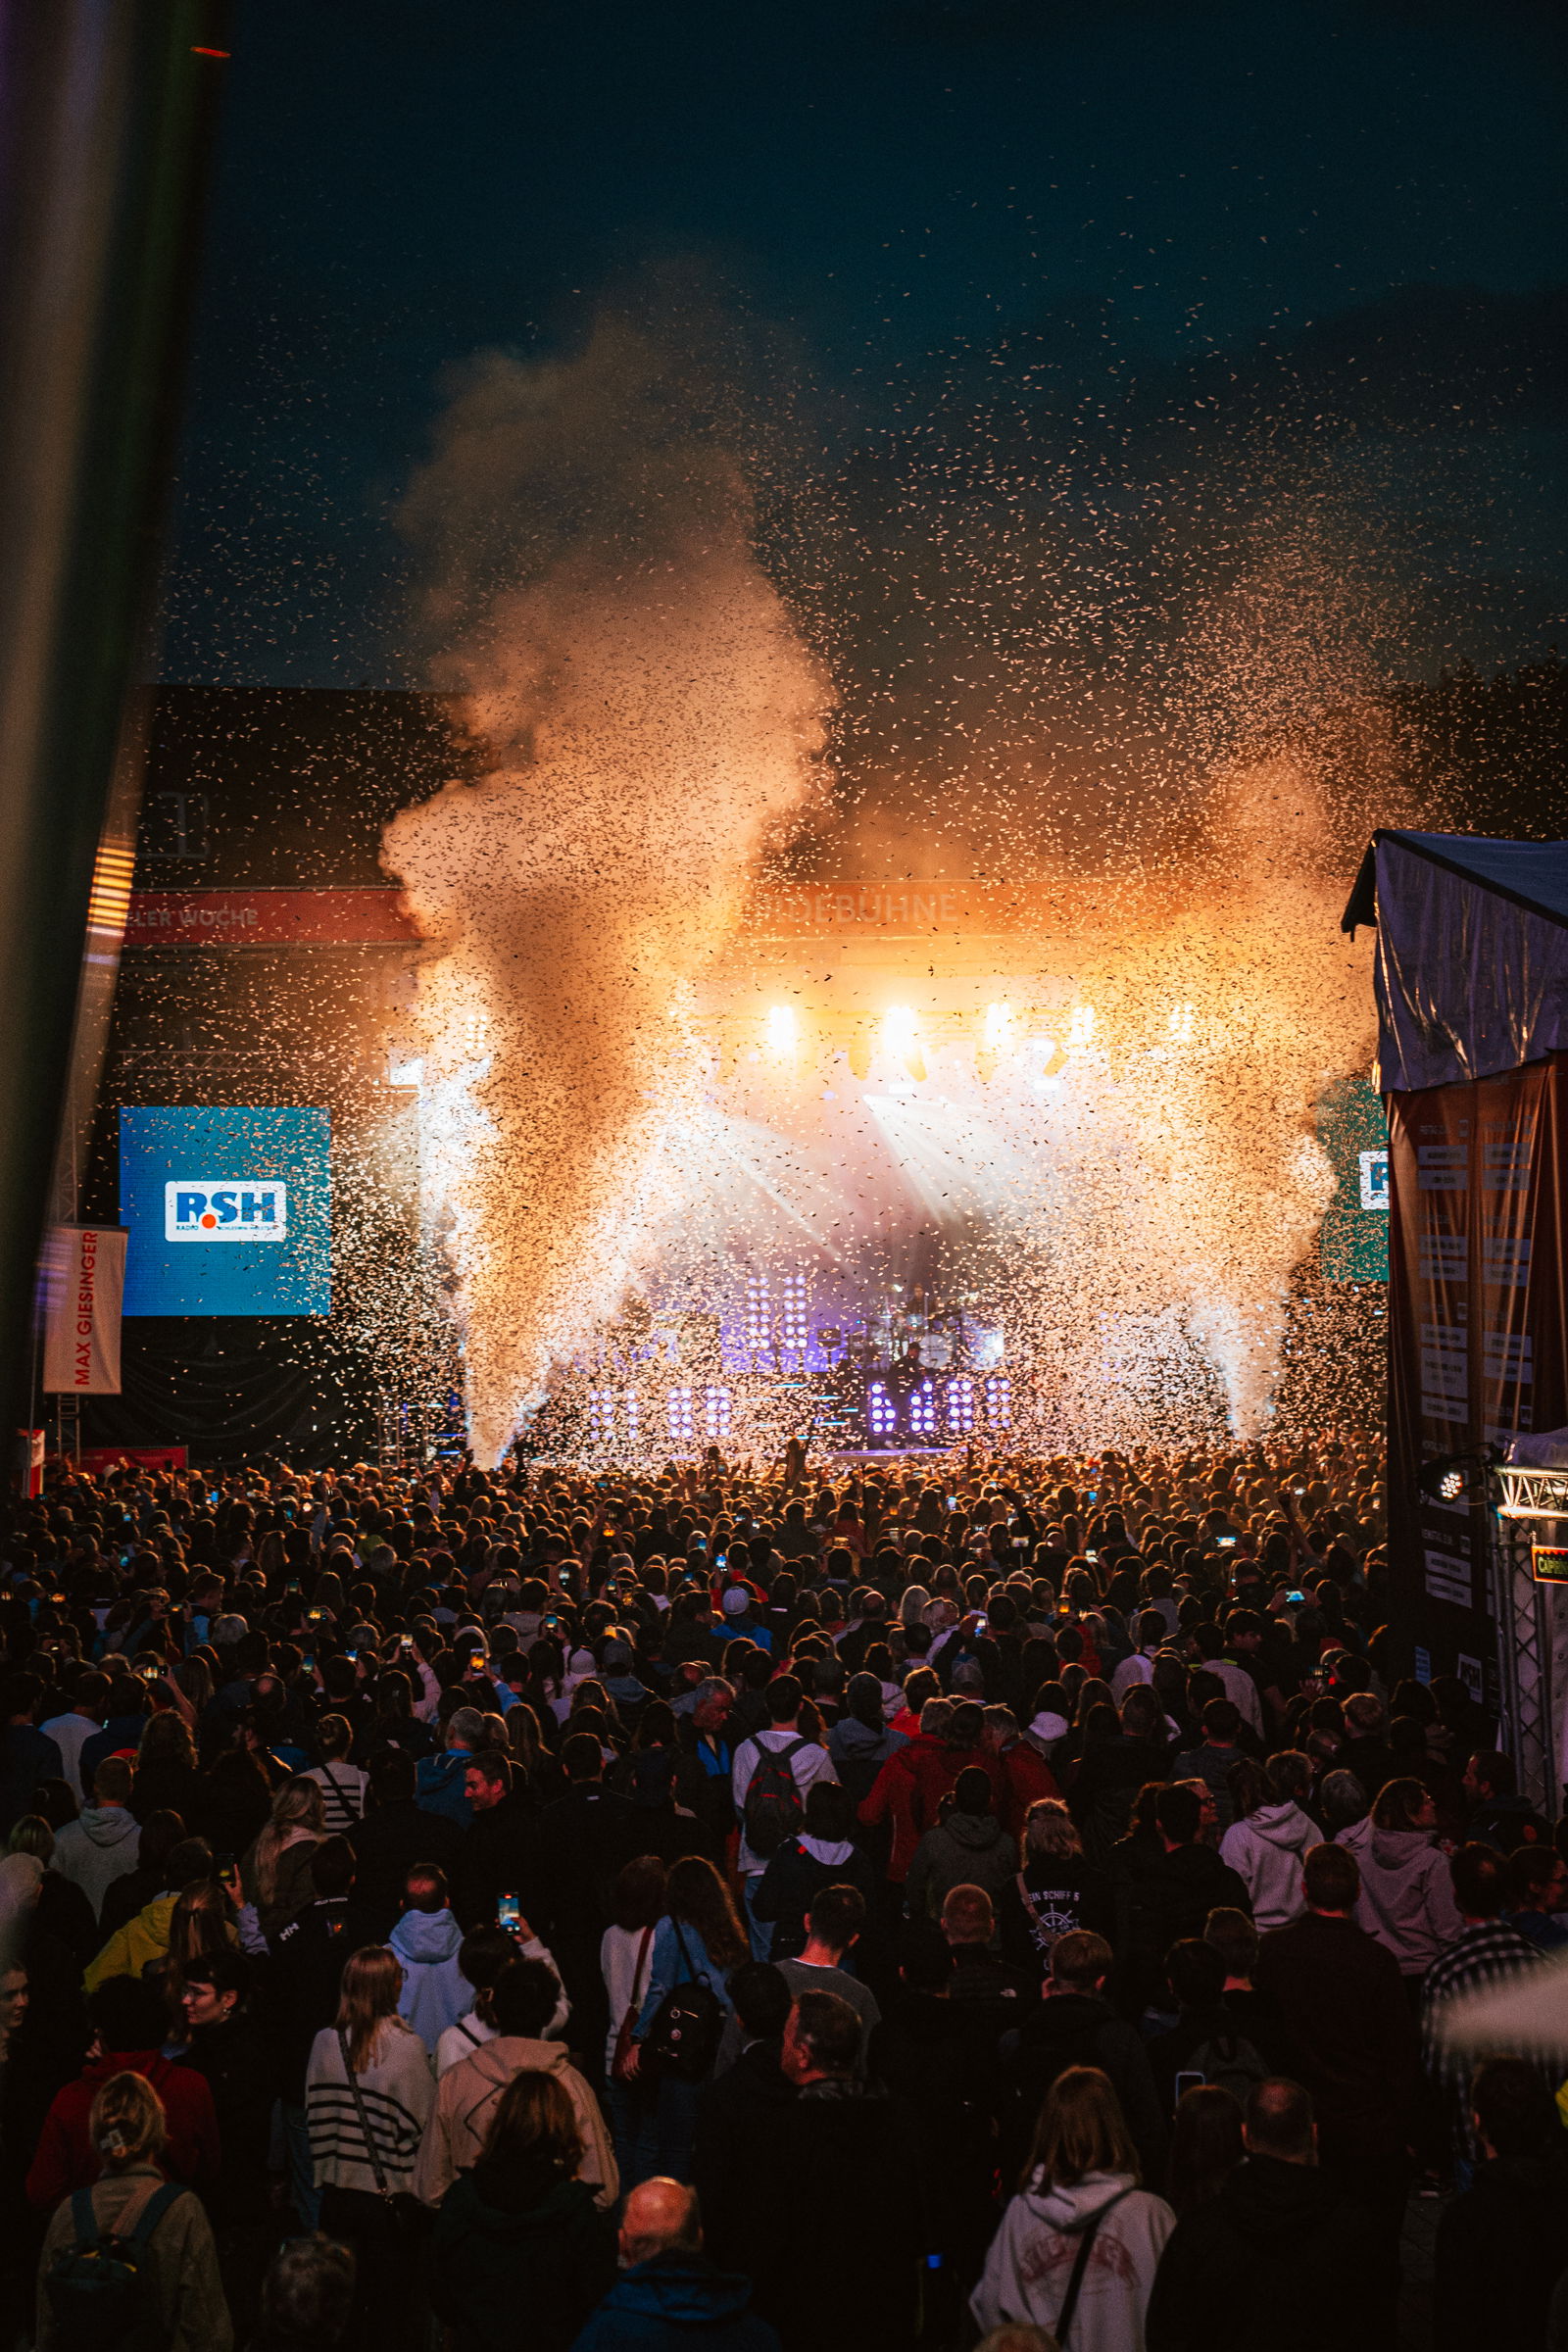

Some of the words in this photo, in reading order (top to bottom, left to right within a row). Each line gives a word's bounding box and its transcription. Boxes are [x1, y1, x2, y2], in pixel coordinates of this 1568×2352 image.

[126, 910, 172, 927] ELER
[179, 909, 259, 926] WOCHE
[76, 1231, 98, 1336] GIESINGER
[74, 1342, 91, 1385] MAX
[1043, 1890, 1071, 1900] SCHIFF
